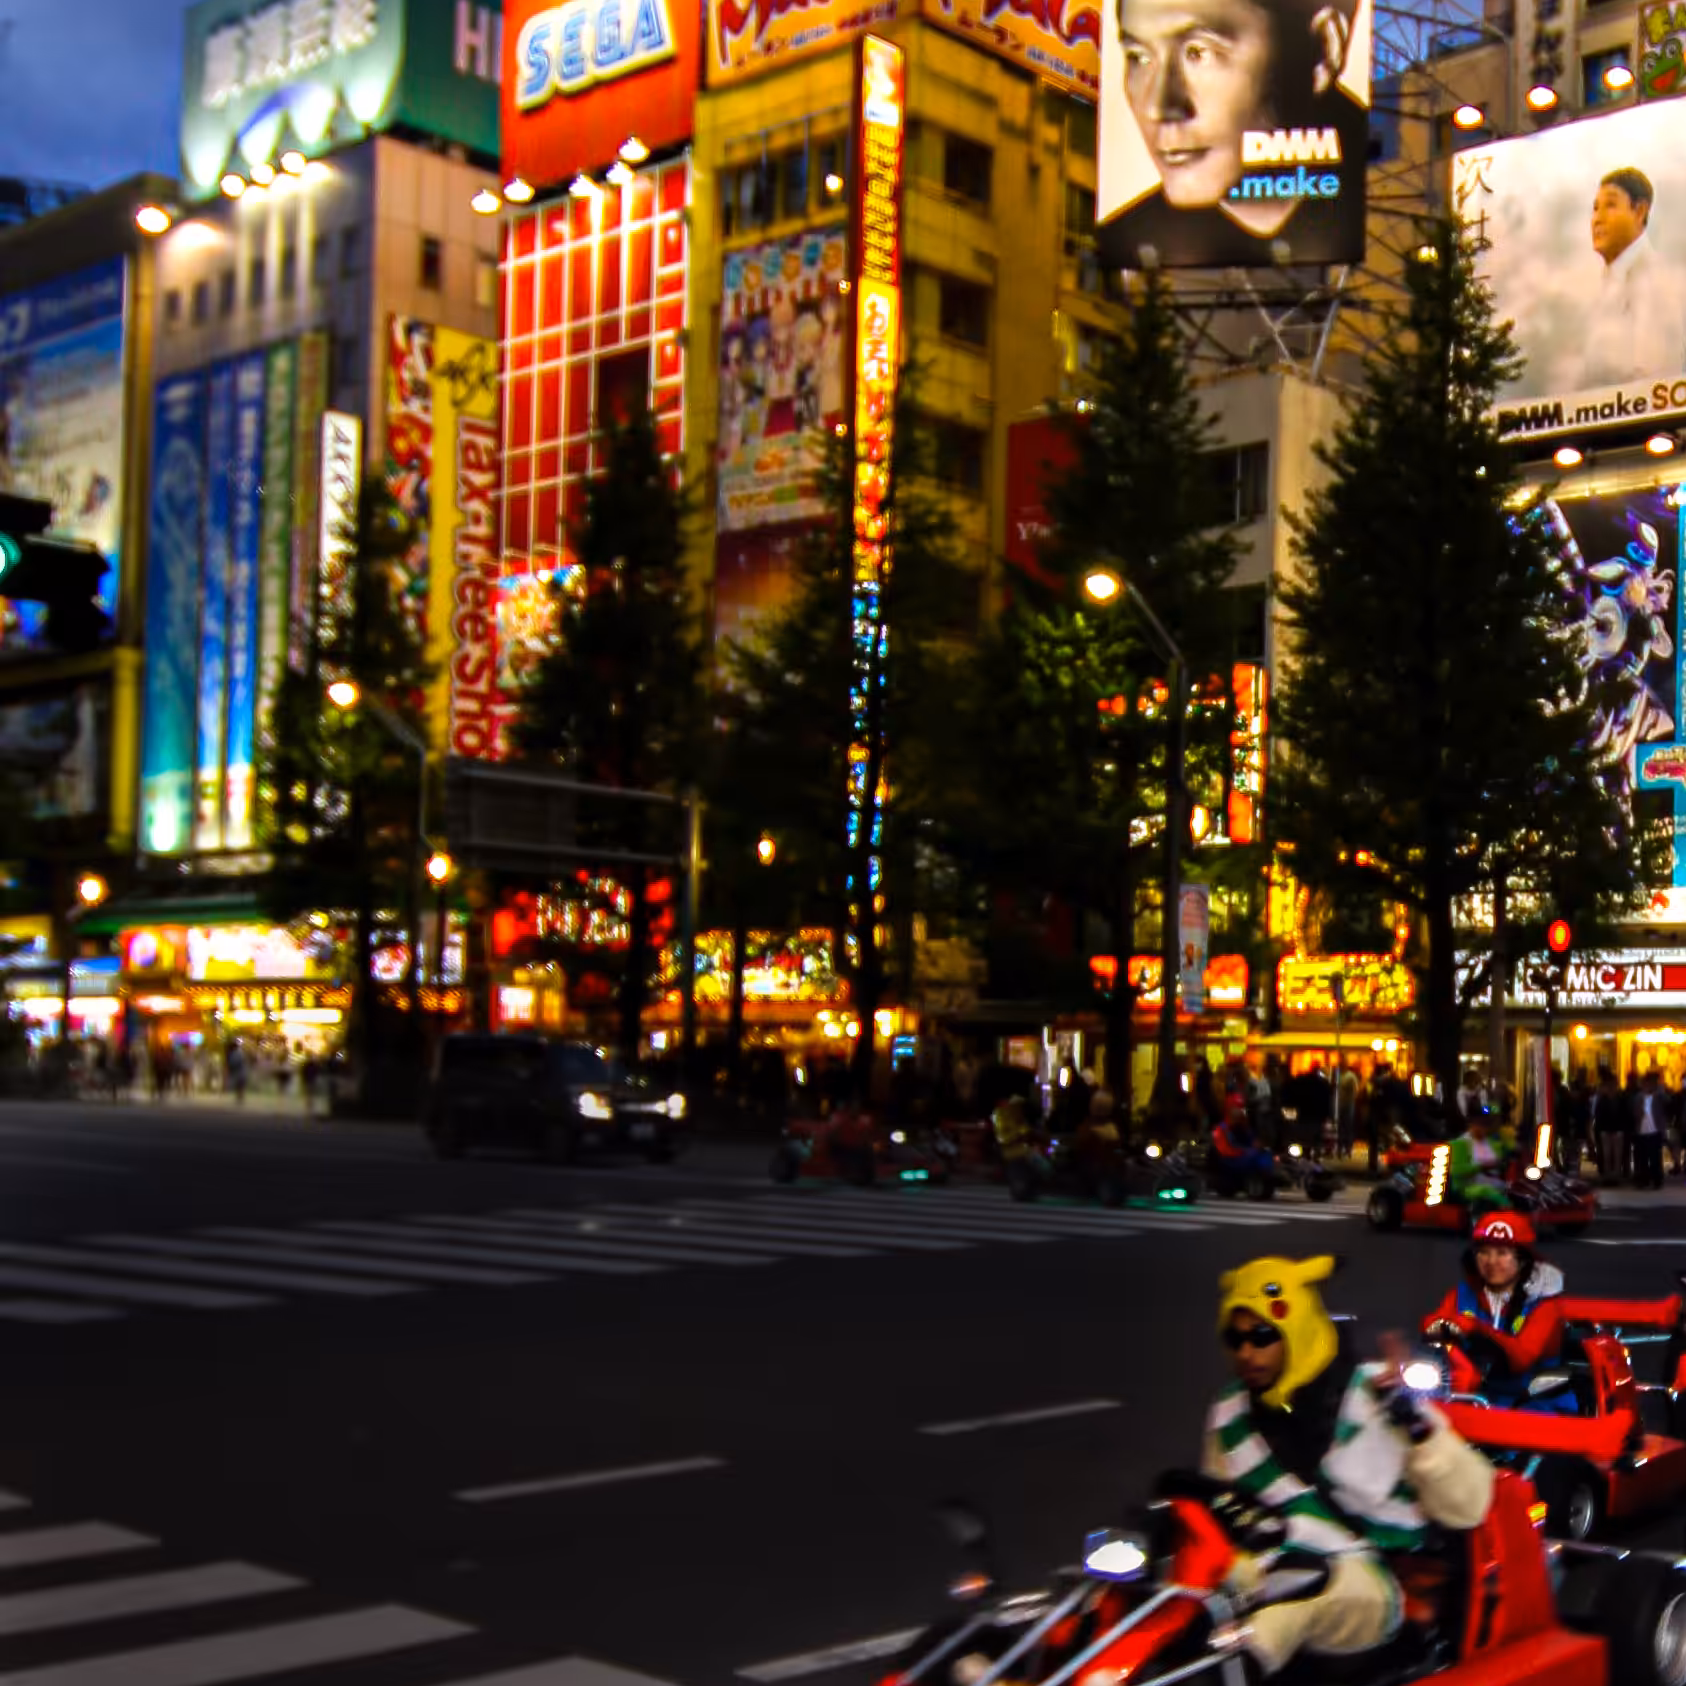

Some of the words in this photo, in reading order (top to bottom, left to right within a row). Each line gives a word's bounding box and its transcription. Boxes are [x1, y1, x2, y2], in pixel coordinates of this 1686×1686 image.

[1240, 127, 1342, 167] DMM
[1228, 166, 1341, 201] .make
[1622, 963, 1663, 991] ZIN
